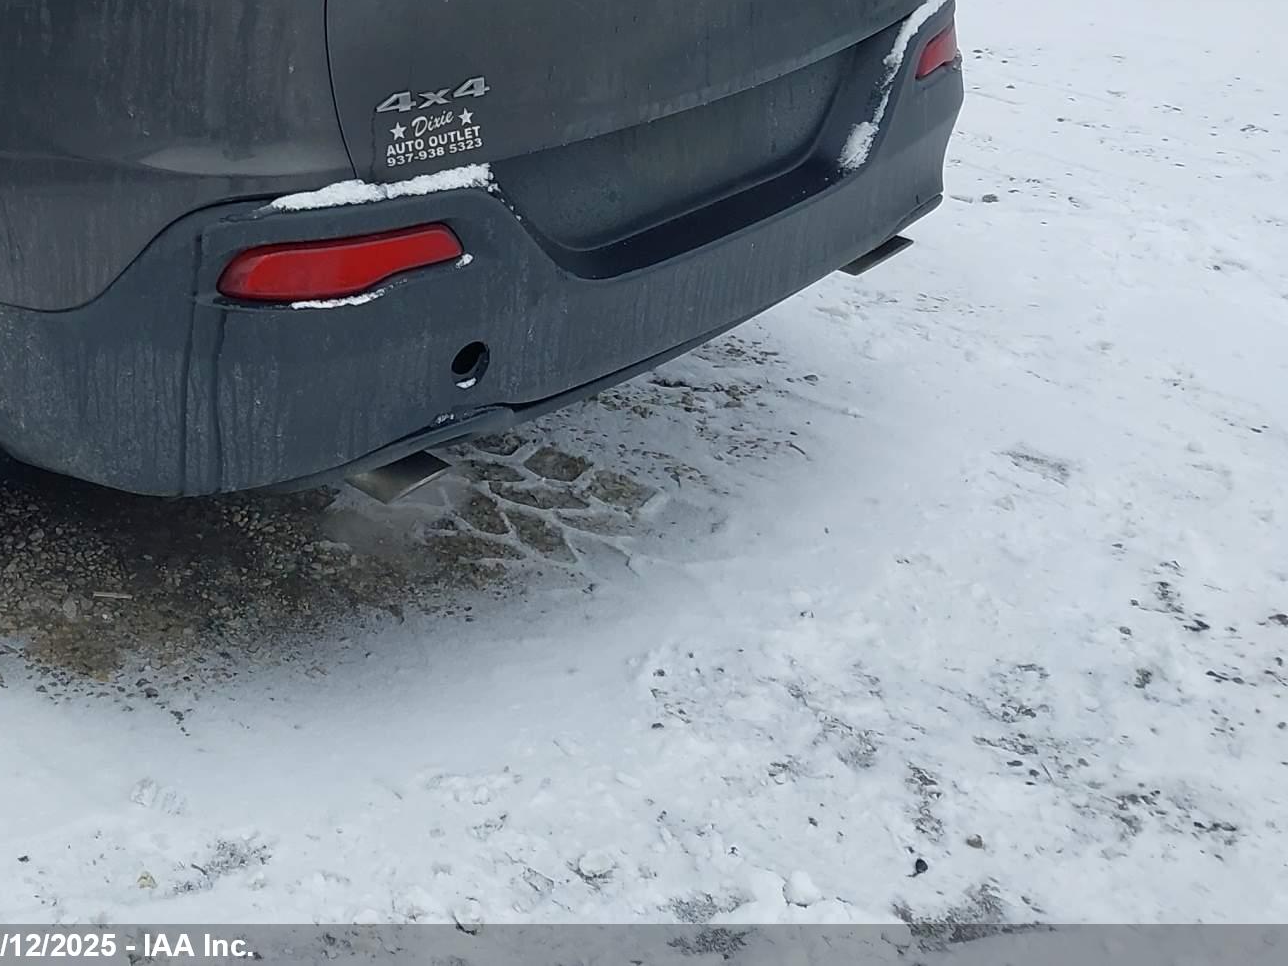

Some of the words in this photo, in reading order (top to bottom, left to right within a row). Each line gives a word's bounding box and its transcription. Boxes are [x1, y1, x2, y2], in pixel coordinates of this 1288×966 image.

[376, 76, 490, 113] 4x4
[411, 110, 454, 137] Dixie
[386, 138, 425, 157] AUTO
[428, 125, 481, 147] OUTLET
[386, 146, 445, 167] 937-938
[449, 137, 483, 154] 5323
